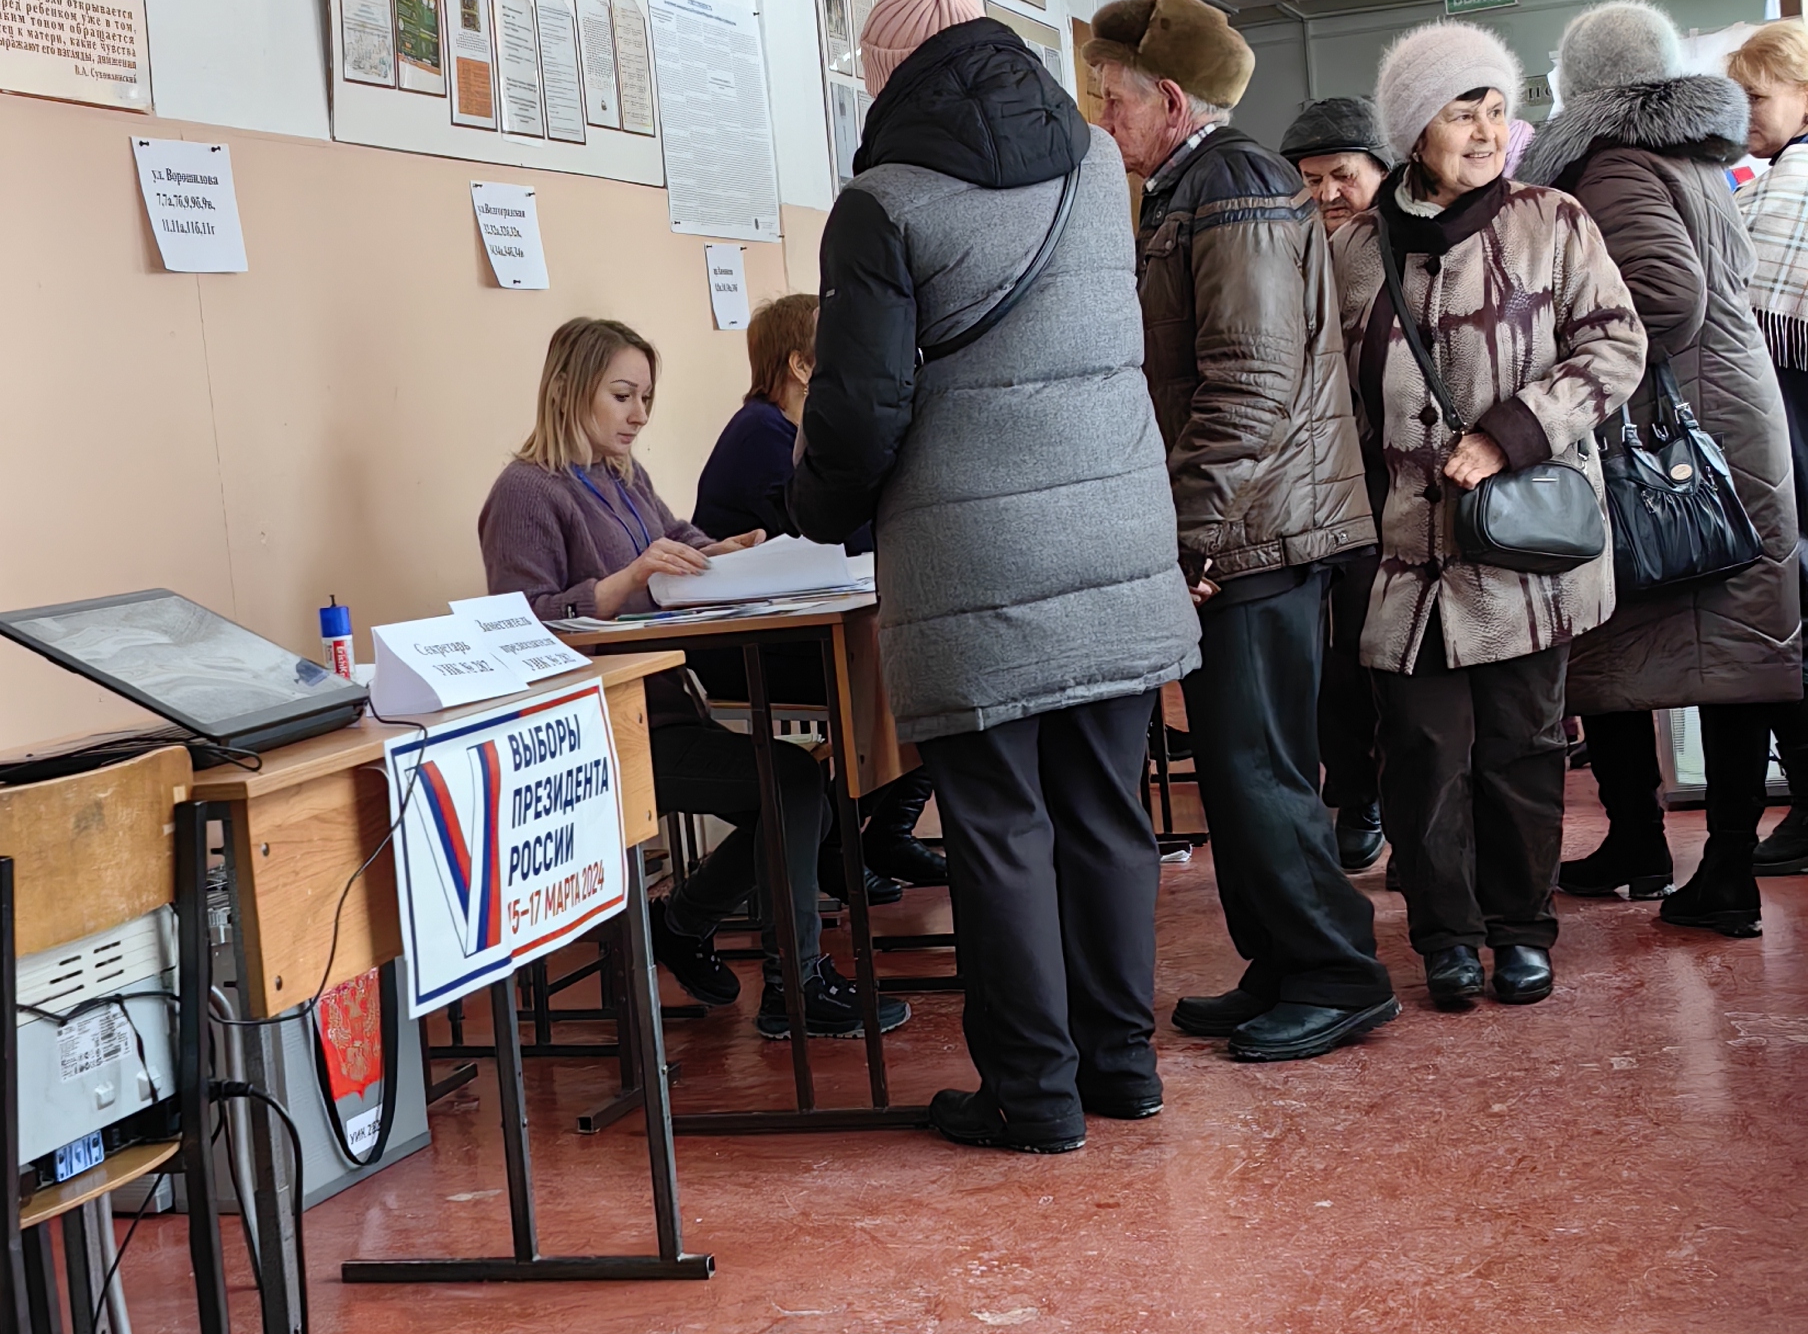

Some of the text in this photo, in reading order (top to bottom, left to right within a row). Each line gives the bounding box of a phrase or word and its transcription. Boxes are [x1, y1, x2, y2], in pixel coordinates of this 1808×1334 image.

[26, 2, 77, 21] ребенком
[81, 14, 101, 27] уже
[67, 0, 133, 20] открывается
[27, 29, 66, 46] матери,
[70, 37, 97, 50] какие
[100, 42, 137, 57] чувства
[30, 17, 65, 32] тоном
[69, 22, 135, 45] обращается
[165, 167, 219, 186] Ворошилова
[475, 616, 533, 632] Заместитель
[413, 641, 472, 658] Секретарь
[432, 663, 461, 676] УИК
[507, 713, 581, 772] ВЫБОРЫ
[511, 756, 609, 829] ПРЕЗИДЕНТА
[507, 822, 575, 887] РОССИИ
[544, 867, 581, 921] МАРТА
[581, 859, 605, 901] 2024
